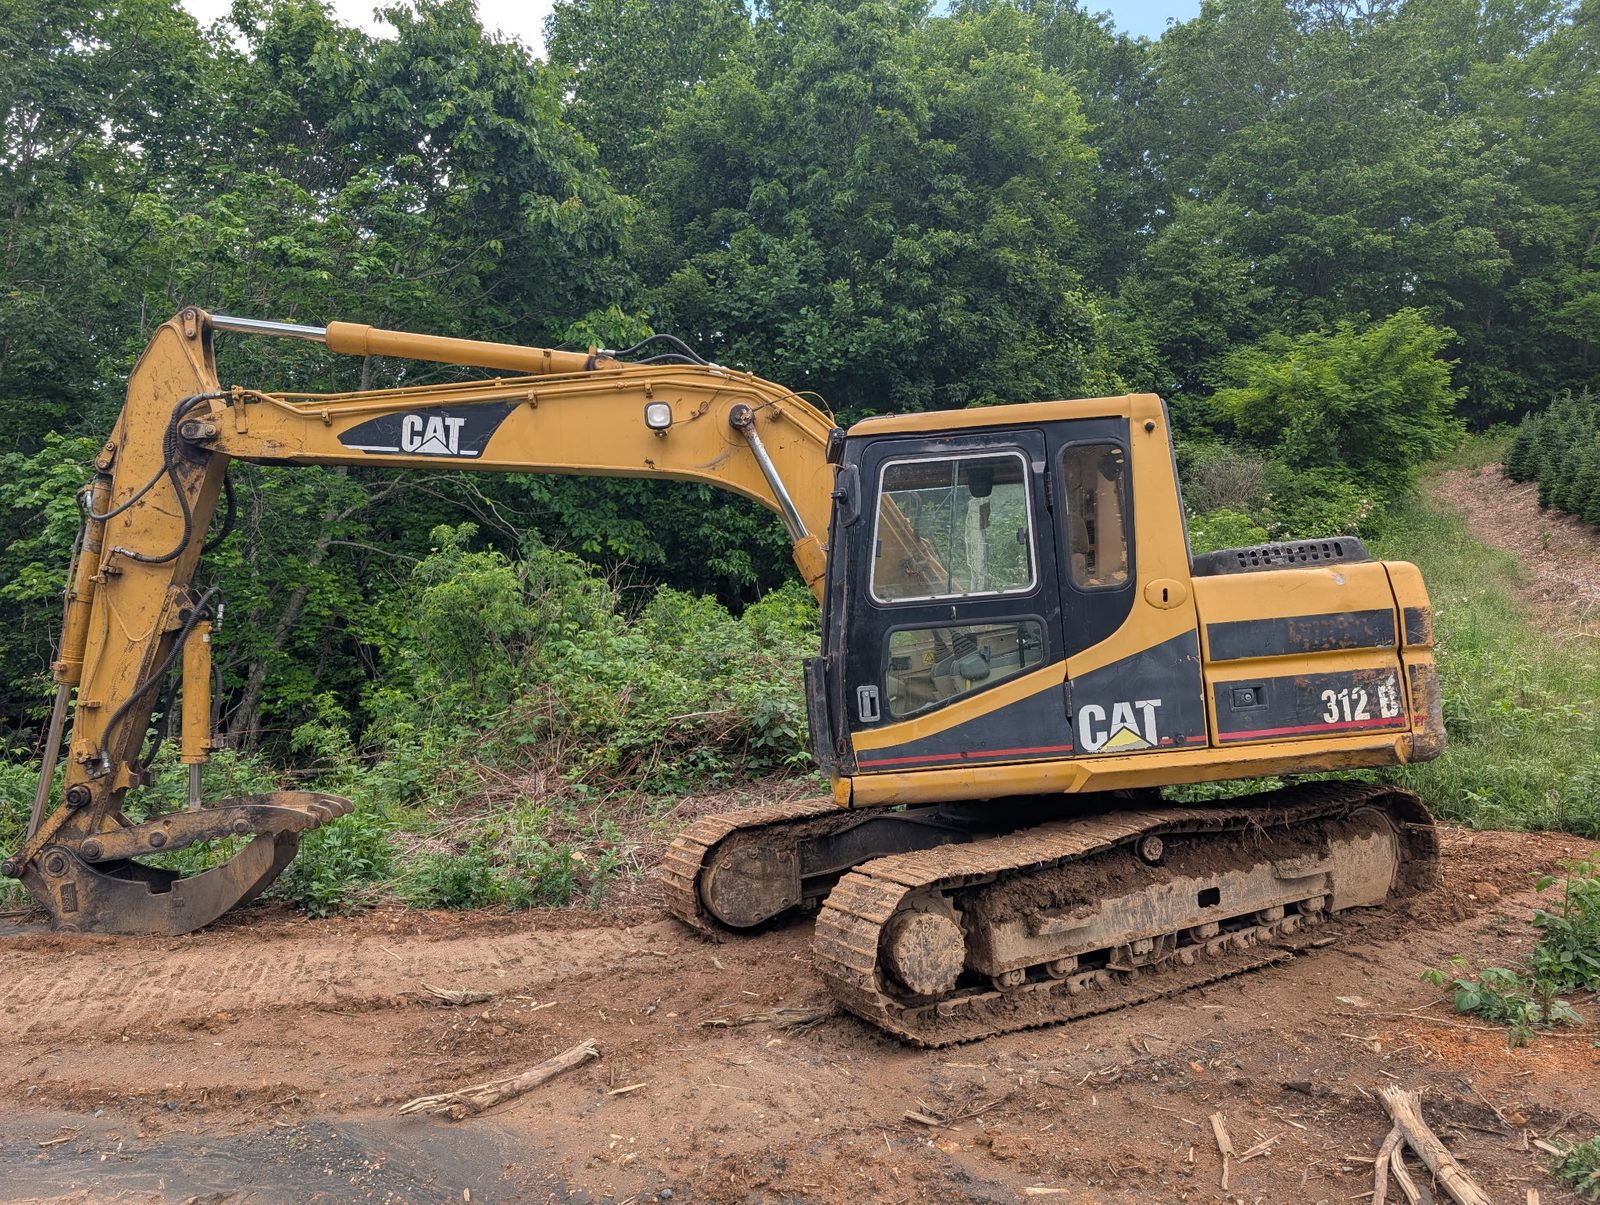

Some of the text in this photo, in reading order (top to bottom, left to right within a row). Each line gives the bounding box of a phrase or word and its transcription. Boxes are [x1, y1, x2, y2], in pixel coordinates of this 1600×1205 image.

[401, 415, 464, 454] CAT
[1321, 687, 1370, 724] 312
[1079, 699, 1161, 752] CAT
